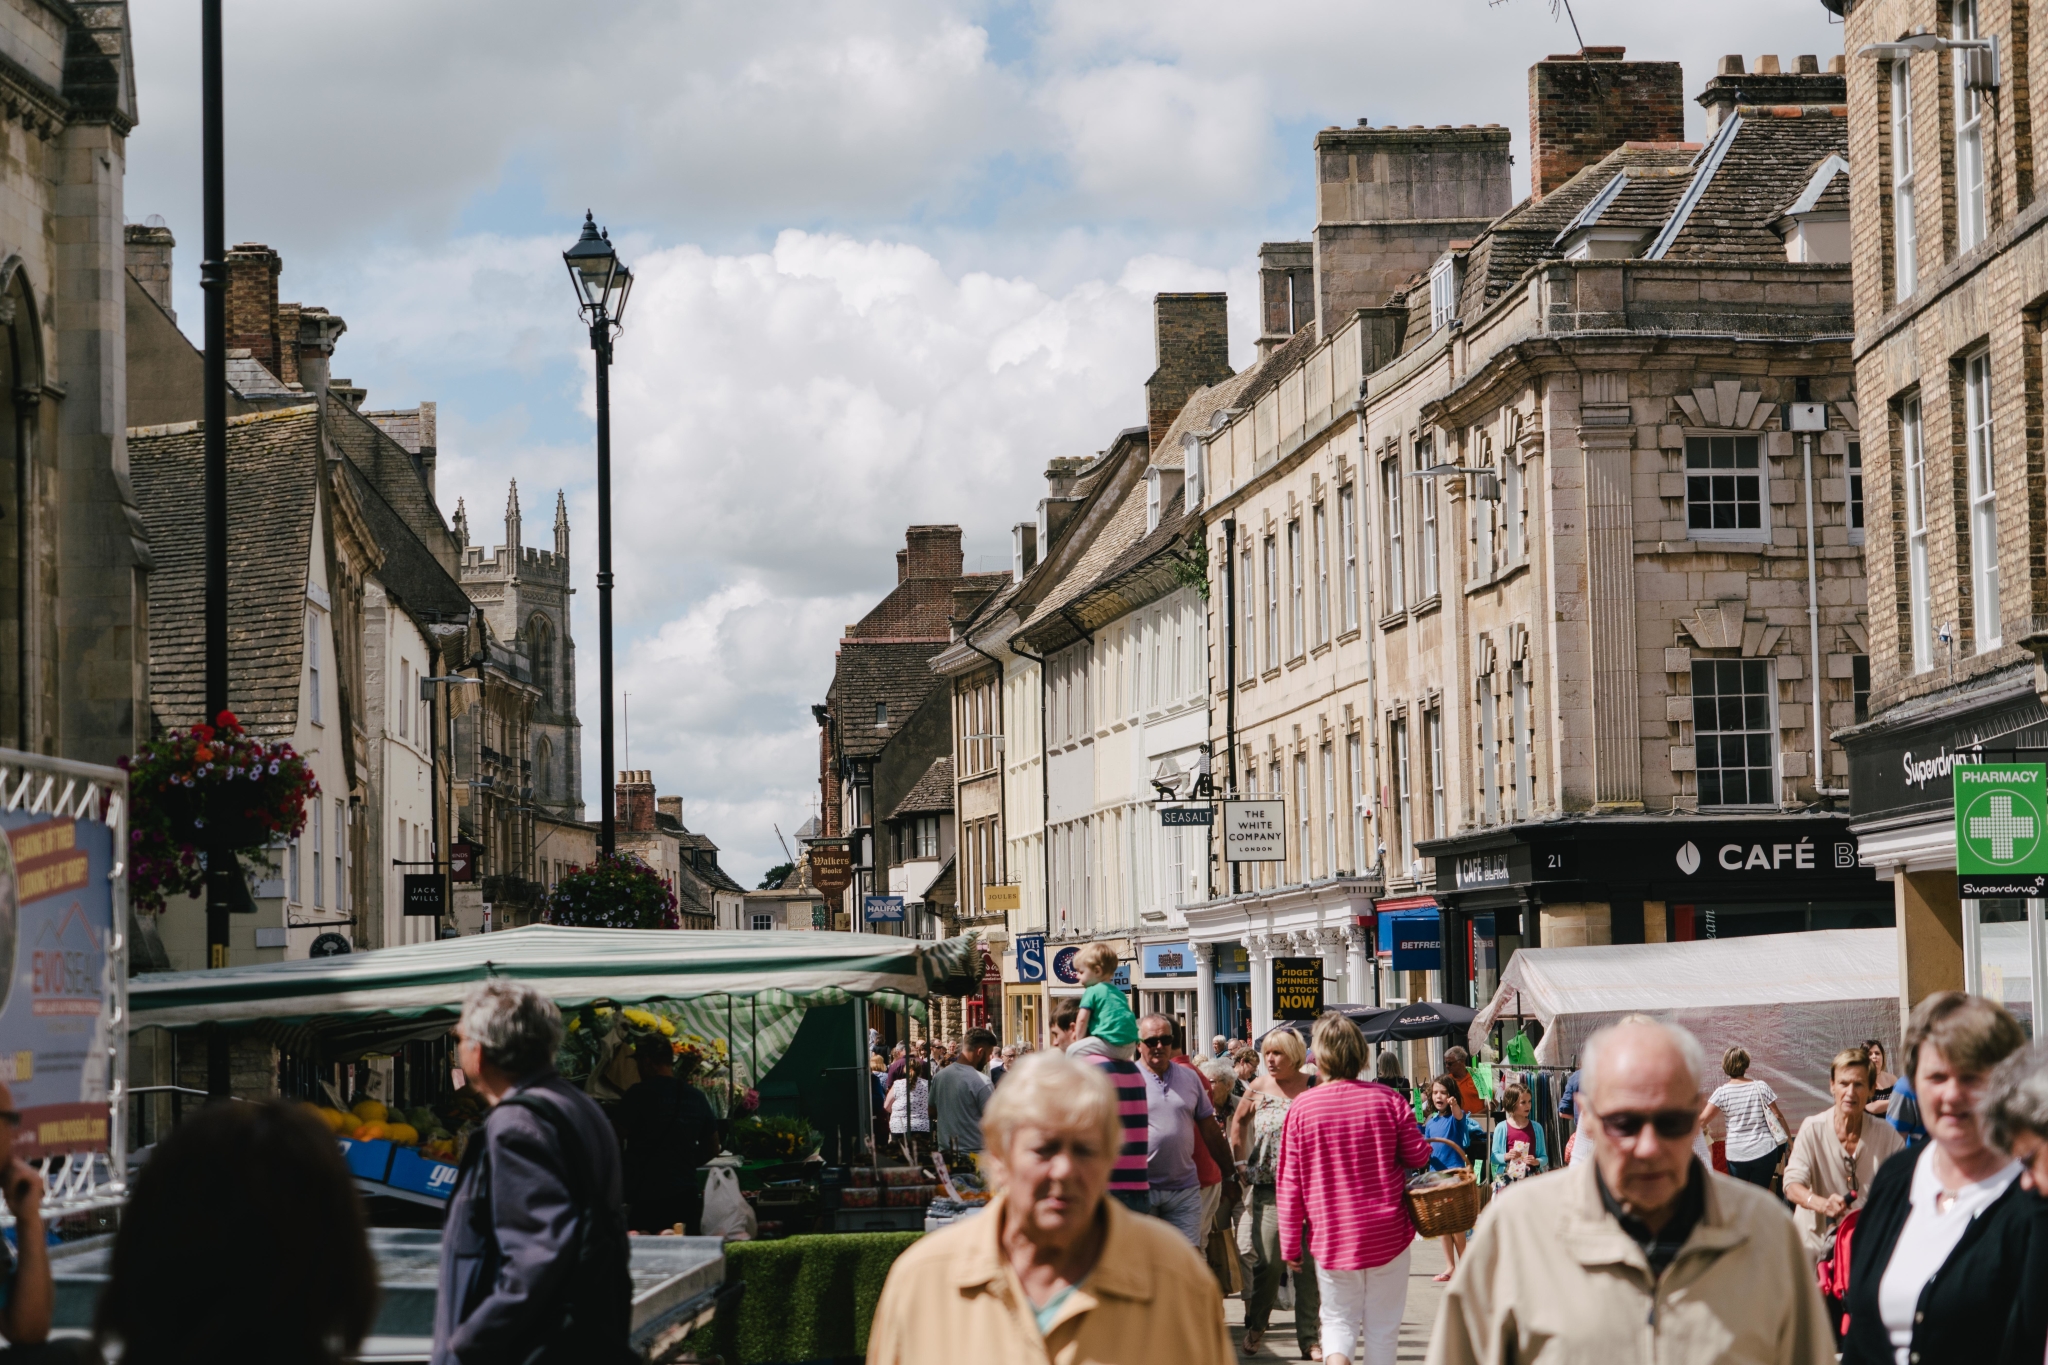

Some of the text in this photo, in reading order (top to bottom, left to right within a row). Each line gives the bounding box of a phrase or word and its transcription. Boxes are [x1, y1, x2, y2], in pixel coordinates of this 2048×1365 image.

[1962, 771, 2039, 783] PHARMACY
[1164, 811, 1211, 823] SEASALT
[1245, 810, 1265, 818] THE
[1238, 821, 1273, 830] WHITE
[1228, 832, 1282, 841] COMPANY
[1717, 836, 1815, 871] CAFÉ
[813, 857, 850, 866] Walkers
[1548, 854, 1561, 868] 21
[820, 867, 843, 876] Books
[1963, 884, 2039, 895] Superdrug
[988, 893, 1017, 901] JOULES
[867, 905, 902, 913] HALIFAX
[1021, 939, 1040, 950] WH
[1401, 940, 1441, 950] BETFRED
[1022, 949, 1044, 980] S
[1276, 977, 1319, 985] SPINNERS
[1277, 986, 1319, 994] IN STOCK
[1280, 995, 1315, 1009] NOW
